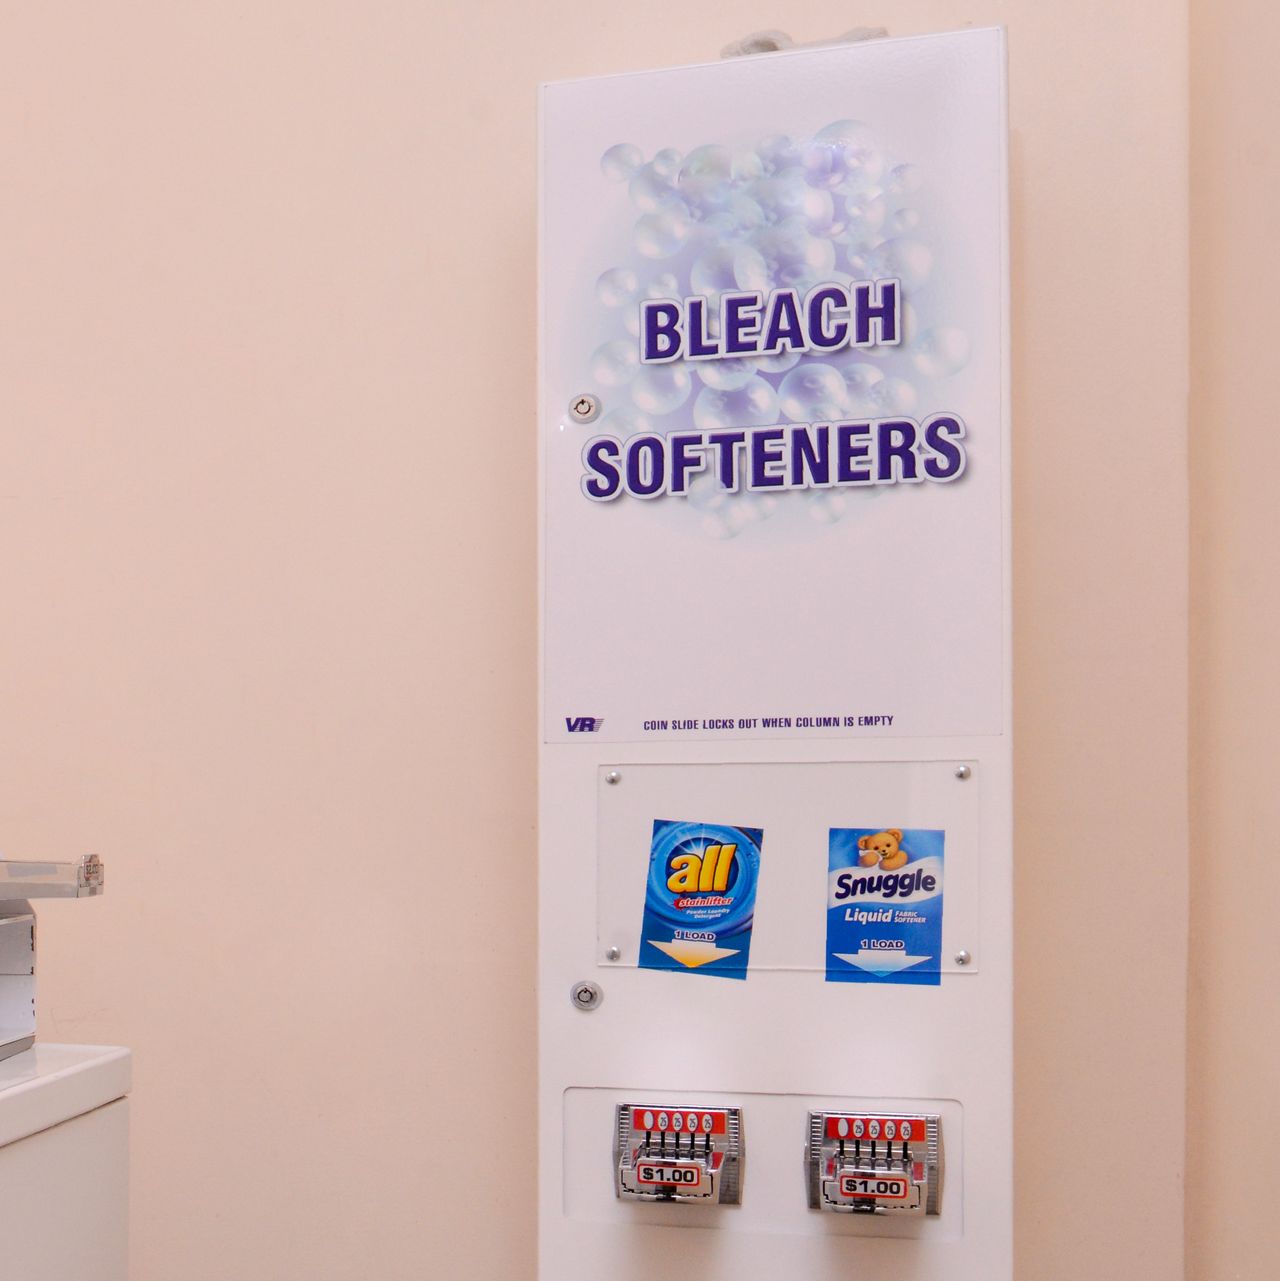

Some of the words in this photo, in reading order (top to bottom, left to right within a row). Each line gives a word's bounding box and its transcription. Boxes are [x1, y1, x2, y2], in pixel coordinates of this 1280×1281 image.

[644, 281, 898, 361] BLEACH
[584, 416, 967, 500] SOFTENERS
[643, 720, 668, 731] COIN
[671, 719, 699, 731] SLIDE
[702, 718, 735, 730] LOCKS
[738, 718, 758, 729] OUT
[762, 717, 792, 728] WHEN
[795, 716, 840, 728] COLUMN
[843, 716, 854, 727] IS
[858, 715, 894, 727] EMPTY
[666, 843, 738, 894] all
[834, 868, 937, 900] Snuggle
[678, 896, 734, 908] stainlifter
[844, 907, 894, 925] Liquid
[894, 916, 927, 924] SOFTENER
[895, 910, 918, 918] FABRIC
[674, 930, 681, 938] 1
[684, 931, 716, 941] LOAD
[860, 939, 868, 949] 1
[871, 939, 905, 950] LOAD
[660, 1117, 667, 1127] 25
[674, 1117, 681, 1127] 25
[690, 1118, 697, 1128] 25
[704, 1119, 711, 1129] 25
[855, 1124, 862, 1134] 25
[871, 1125, 878, 1135] 25
[887, 1126, 894, 1136] 25
[903, 1126, 910, 1136] 25
[642, 1167, 695, 1183] $1.00
[845, 1179, 901, 1194] $1.00
